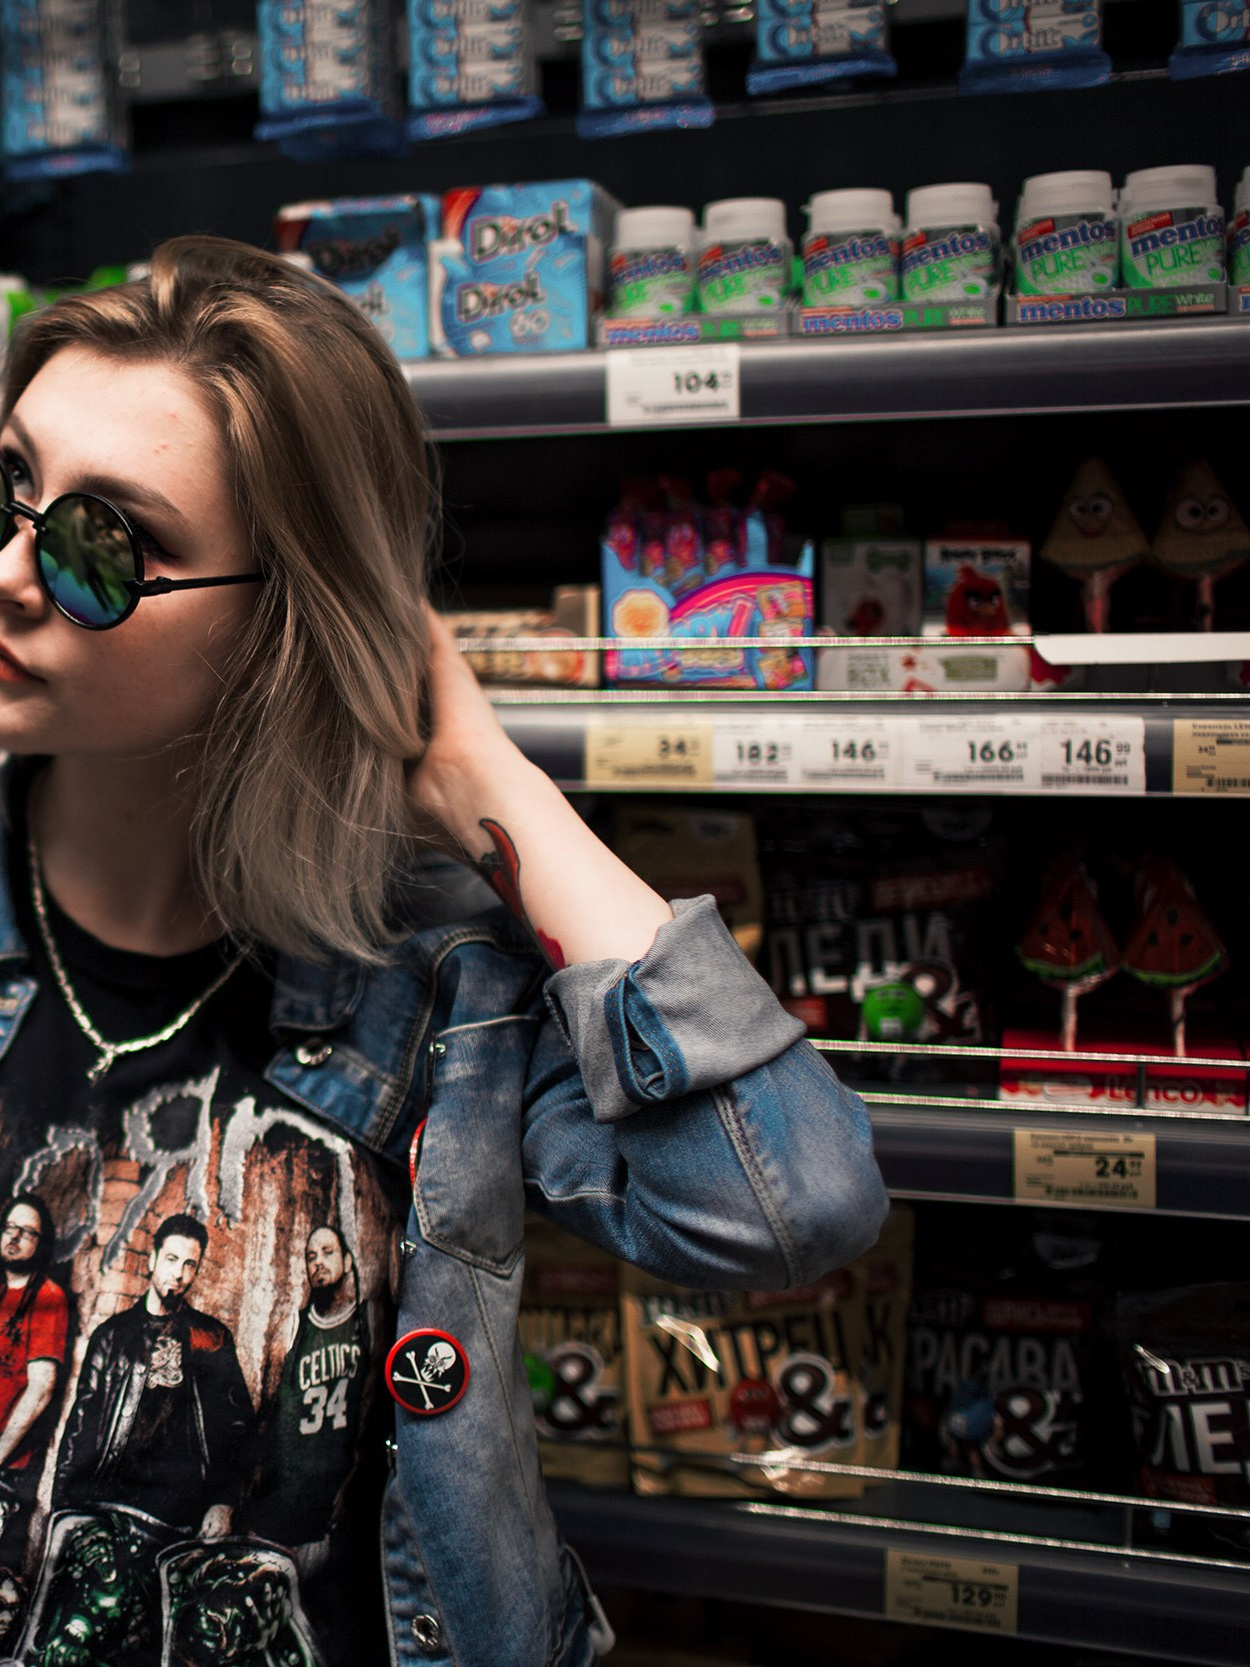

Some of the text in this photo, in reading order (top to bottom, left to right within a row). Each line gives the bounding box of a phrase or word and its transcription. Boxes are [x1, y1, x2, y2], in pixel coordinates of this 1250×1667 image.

[1021, 220, 1116, 264] mentos
[1131, 216, 1225, 258] mentos
[1031, 246, 1087, 283] PURE
[1146, 241, 1203, 275] PURE
[804, 308, 903, 334] mentos
[1019, 296, 1126, 322] mentos
[672, 369, 719, 395] 104
[831, 738, 877, 763] 146
[967, 739, 1015, 763] 166
[1060, 737, 1113, 767] 146
[1095, 1155, 1128, 1179] 24
[299, 1343, 362, 1391] CELTICS
[299, 1378, 350, 1436] 34
[951, 1582, 993, 1607] 129
